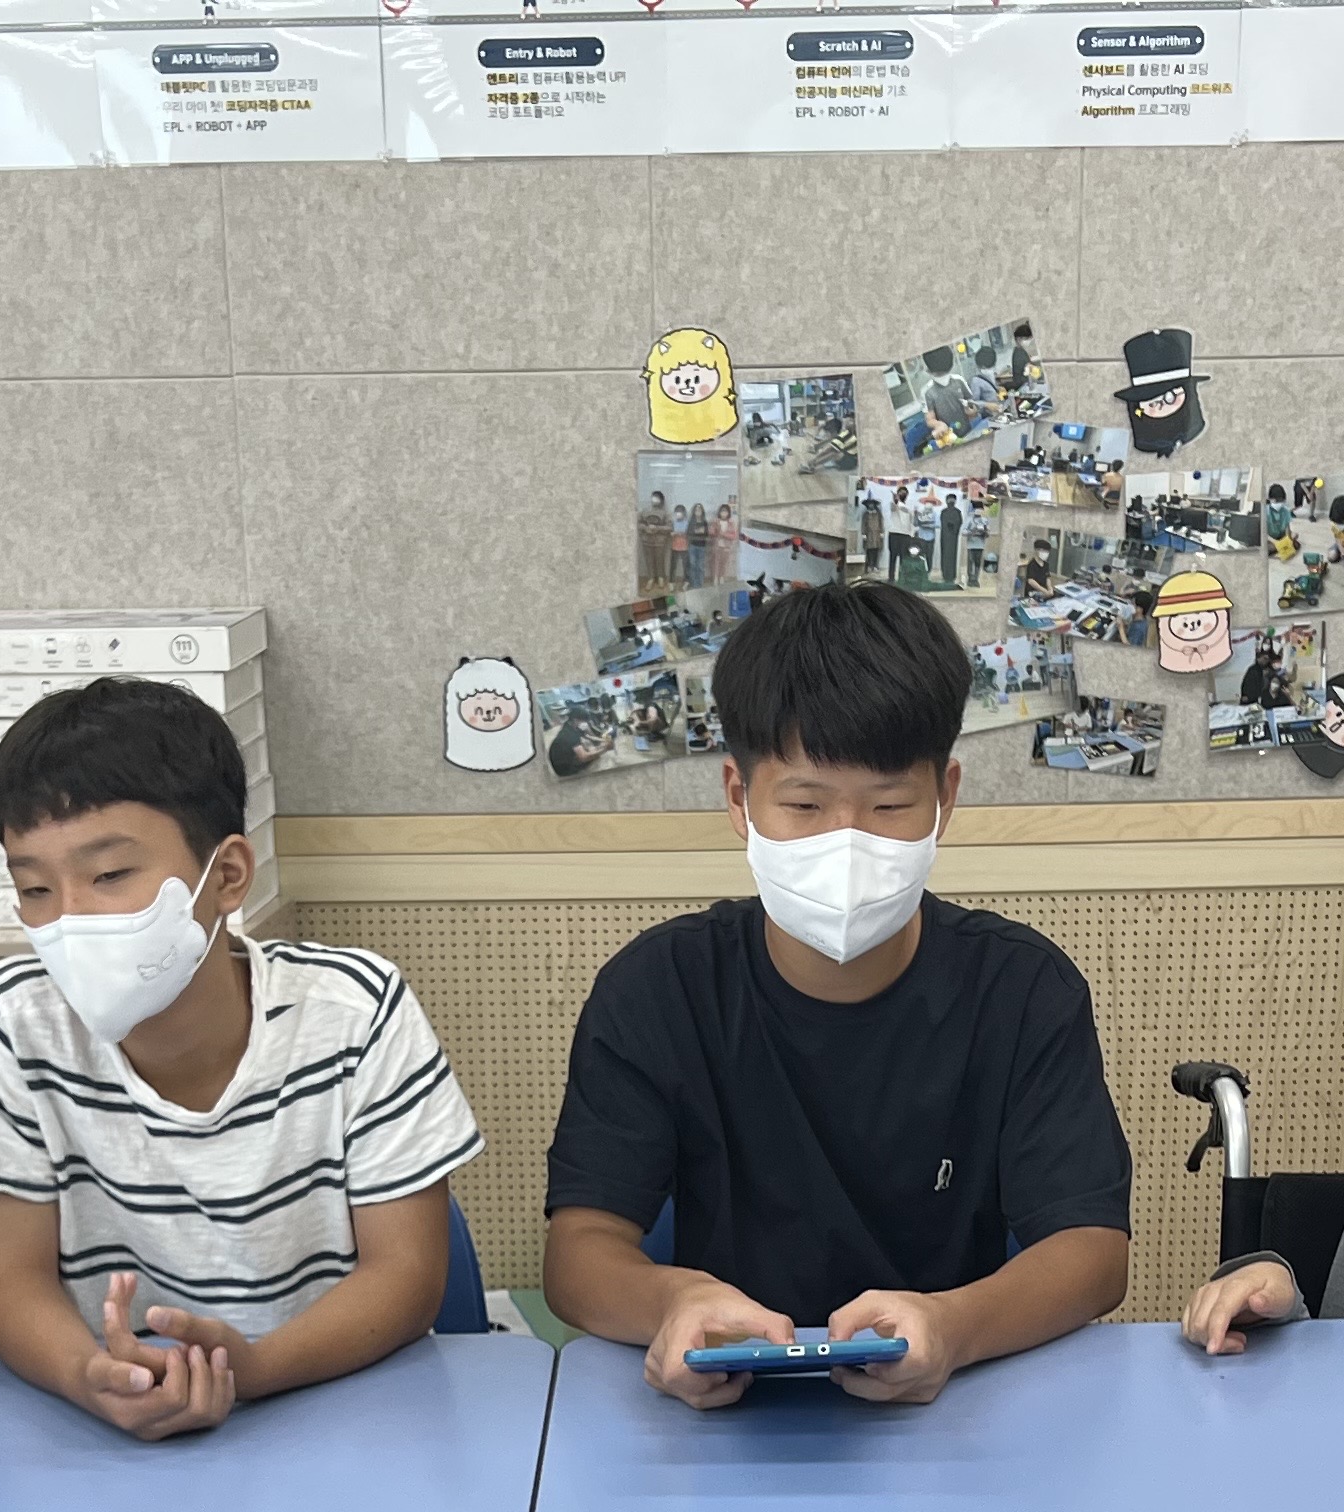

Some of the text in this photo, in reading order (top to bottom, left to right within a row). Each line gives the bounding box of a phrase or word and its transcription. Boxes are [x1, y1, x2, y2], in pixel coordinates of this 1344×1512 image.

[819, 39, 882, 52] Scratch & AI
[1091, 35, 1191, 50] Sensor & Algorithm
[171, 53, 260, 68] APP & Unplugged
[506, 47, 577, 60] Entry & Robot
[796, 64, 910, 79] 컴퓨터 언어의 문법 학습
[1082, 63, 1209, 78] 센서보드를 활용한 AI 코딩
[220, 79, 252, 93] 활용한
[254, 78, 318, 92] 코딩입문과정
[486, 72, 529, 85] 엔트리로
[487, 92, 519, 105] 자격증
[564, 91, 606, 104] 시작하는
[796, 84, 908, 99] 인공지능 머신러닝 기초
[1082, 86, 1125, 98] Physical
[1127, 84, 1187, 98] Computing
[162, 101, 183, 113] 우리
[185, 101, 207, 113] 아이
[226, 99, 278, 112] 코딩자격증
[281, 99, 311, 111] CTAA
[487, 105, 565, 119] 코딩 포트폴리오
[796, 107, 816, 118] EPL
[828, 106, 866, 117] ROBOT
[878, 106, 889, 116] AI
[1081, 103, 1191, 118] Algorithm 프로그래밍
[163, 121, 184, 132] EPL
[196, 121, 233, 132] ROBOT
[246, 120, 267, 131] APP
